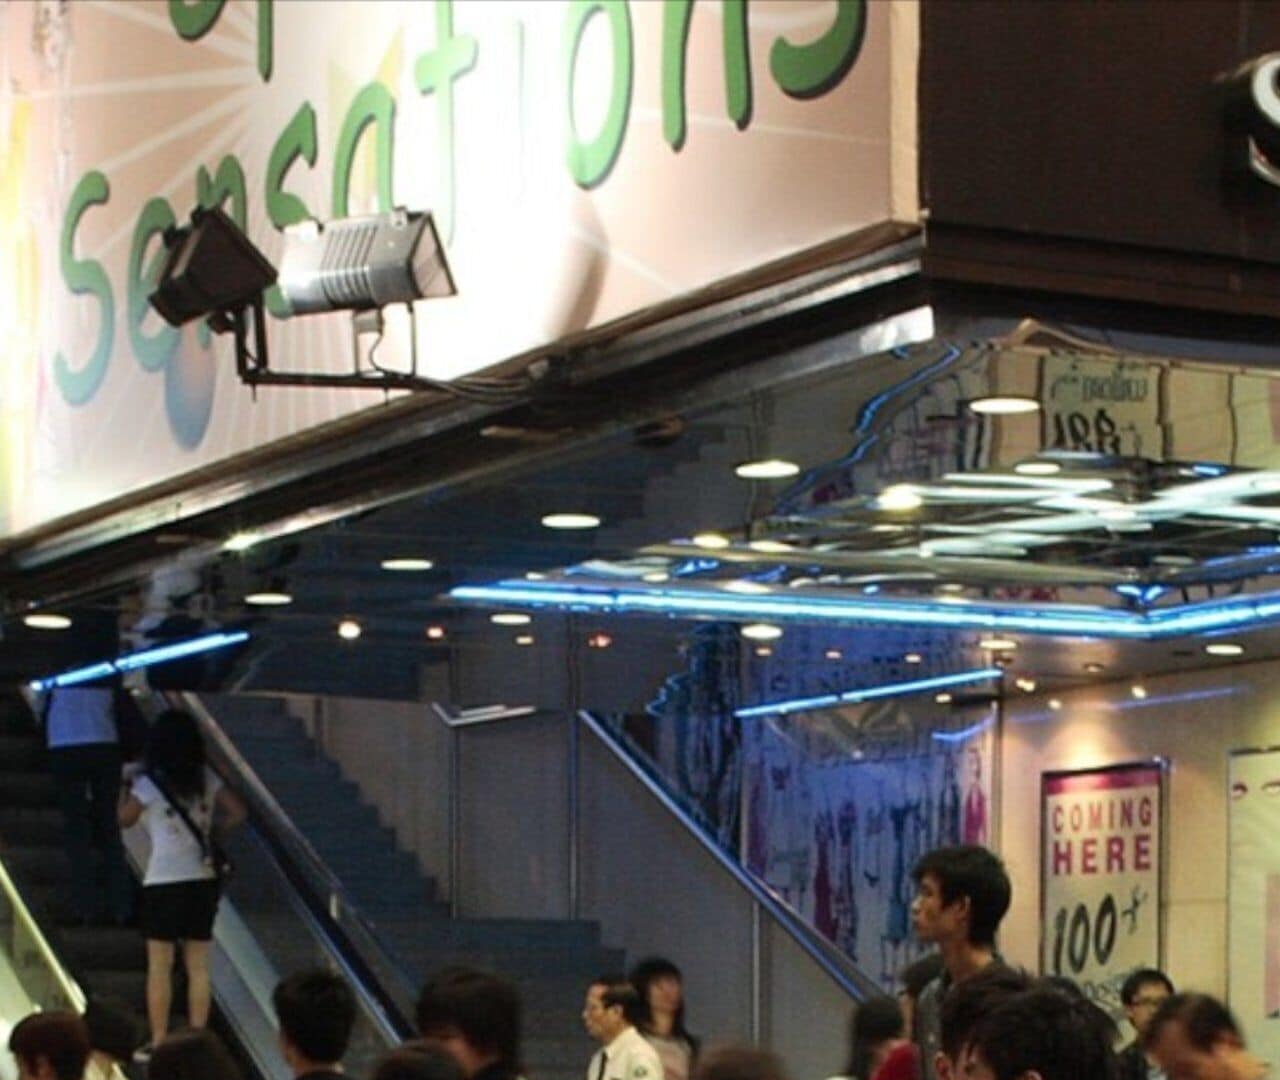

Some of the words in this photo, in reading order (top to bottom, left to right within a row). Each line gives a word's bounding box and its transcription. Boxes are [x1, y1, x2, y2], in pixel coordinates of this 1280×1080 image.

[52, 0, 867, 406] sesaton
[1052, 797, 1153, 833] COMING
[1053, 835, 1152, 876] HERE
